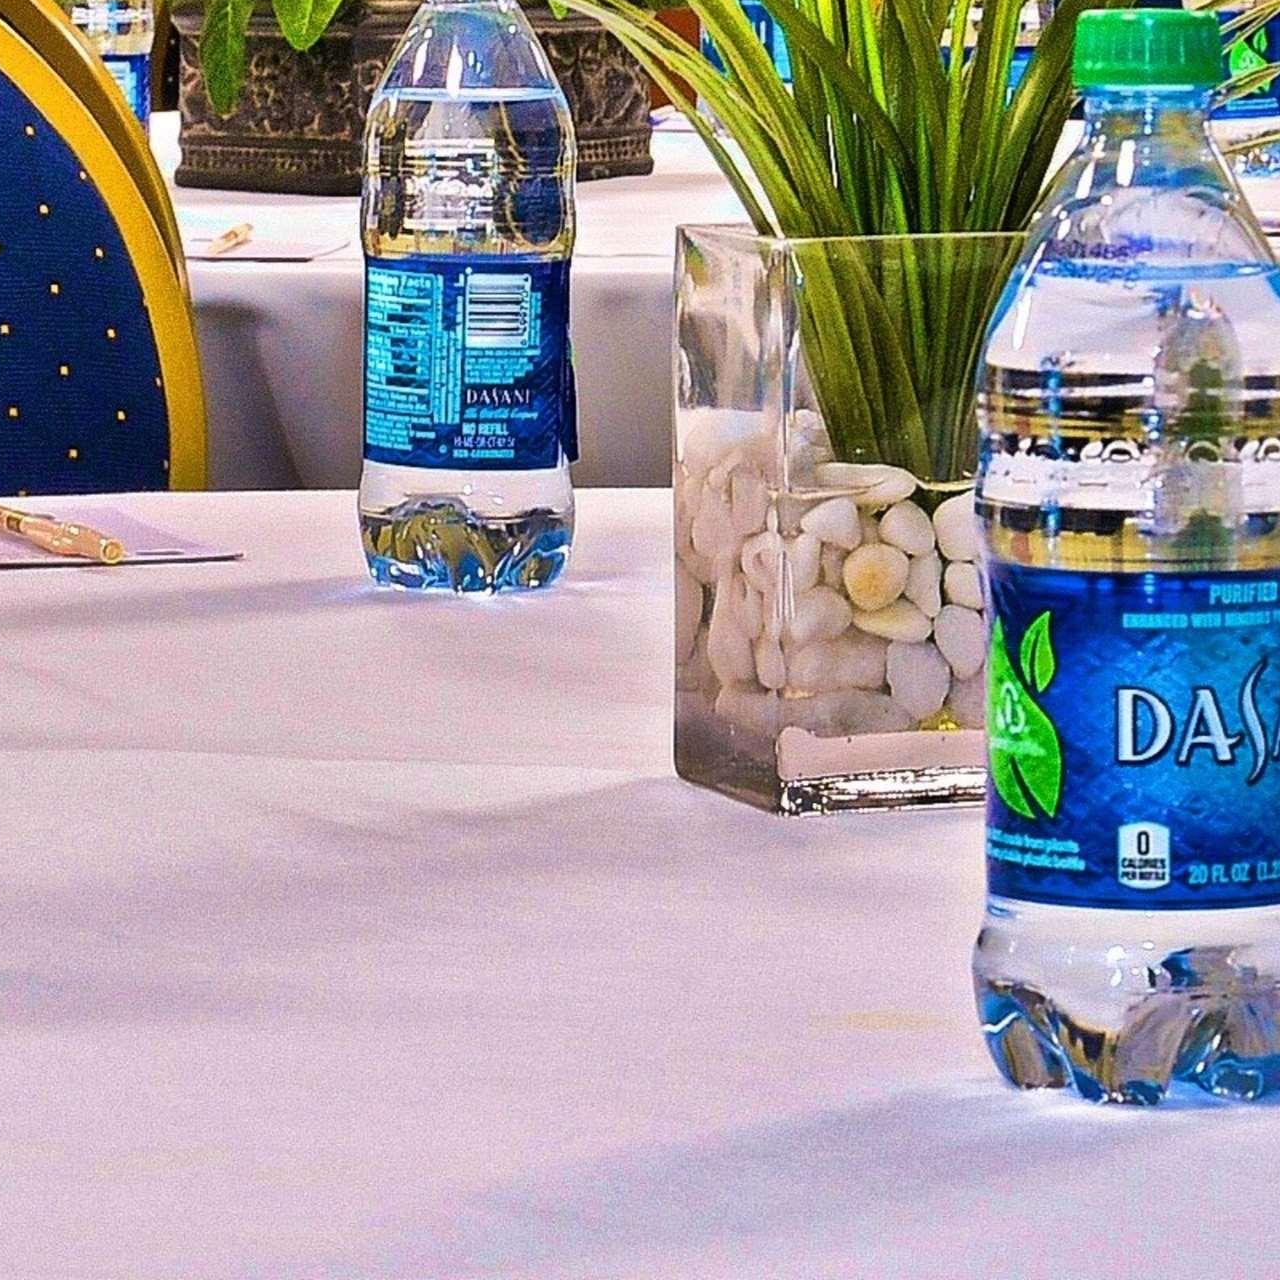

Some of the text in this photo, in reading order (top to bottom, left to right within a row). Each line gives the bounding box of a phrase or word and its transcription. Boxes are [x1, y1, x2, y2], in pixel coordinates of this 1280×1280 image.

[465, 387, 531, 407] DASANI
[1209, 581, 1279, 605] PURIFIED
[1137, 830, 1150, 856] 0
[1121, 857, 1167, 870] CALORIES
[1187, 864, 1209, 885] 20
[1211, 864, 1229, 884] FL
[1231, 863, 1251, 883] OZ
